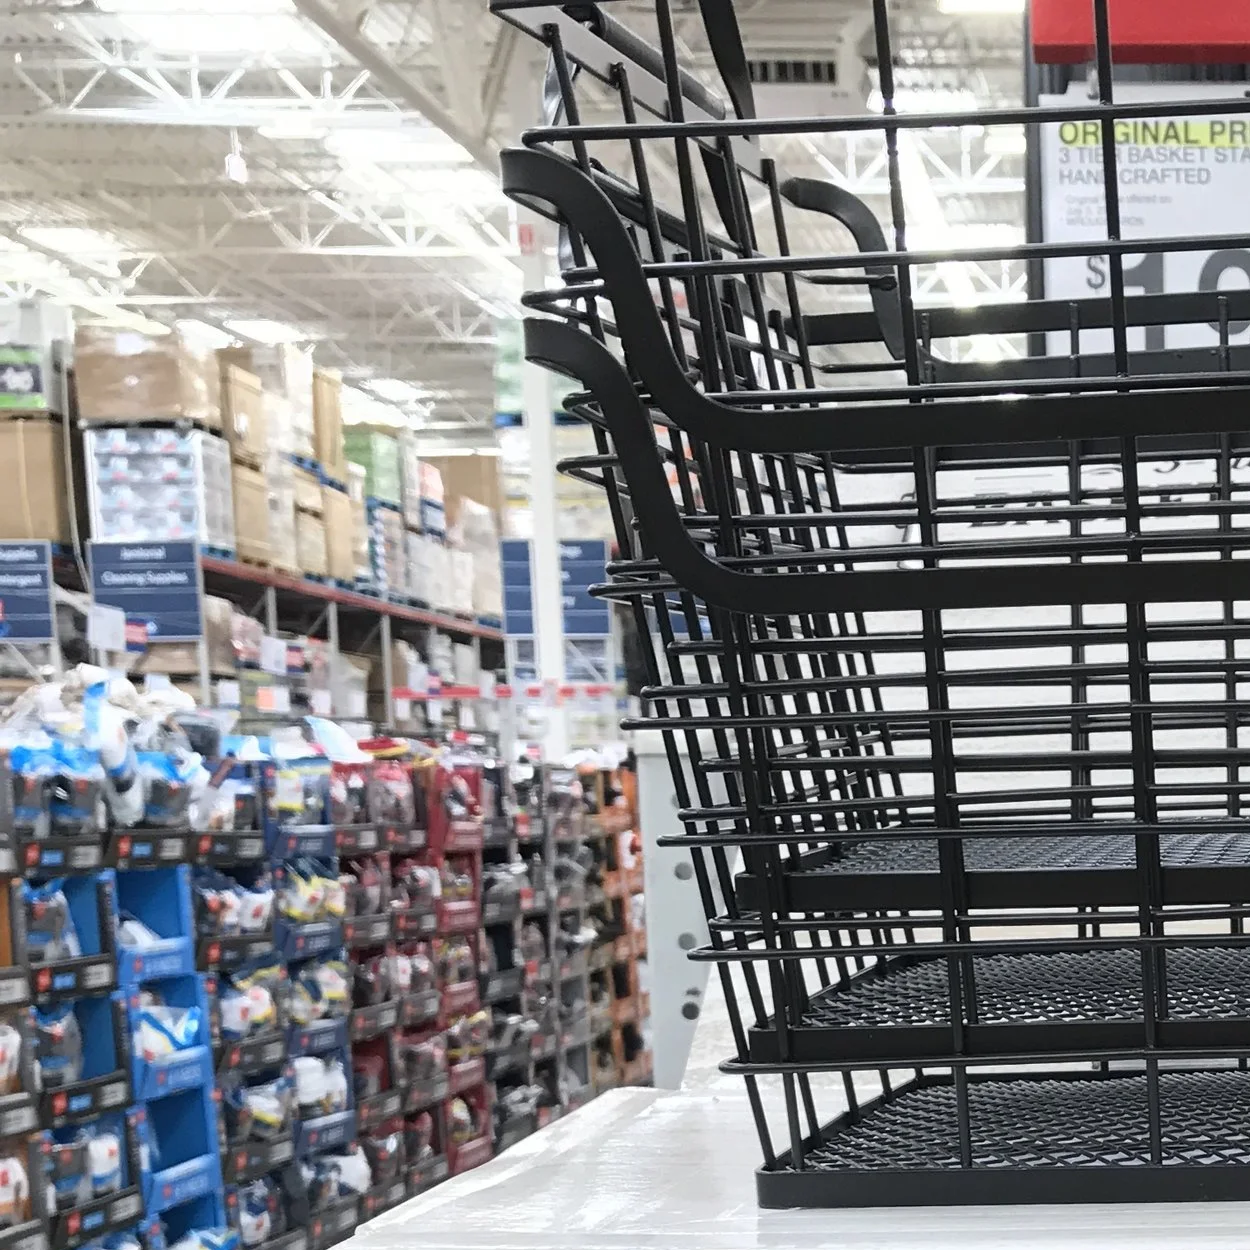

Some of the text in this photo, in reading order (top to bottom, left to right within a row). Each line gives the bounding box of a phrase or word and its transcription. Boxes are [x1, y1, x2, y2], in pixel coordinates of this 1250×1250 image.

[1058, 121, 1199, 146] ORGINAL
[1059, 148, 1070, 165] 3
[1128, 147, 1208, 164] BASKET
[1119, 168, 1211, 185] CRAFTED
